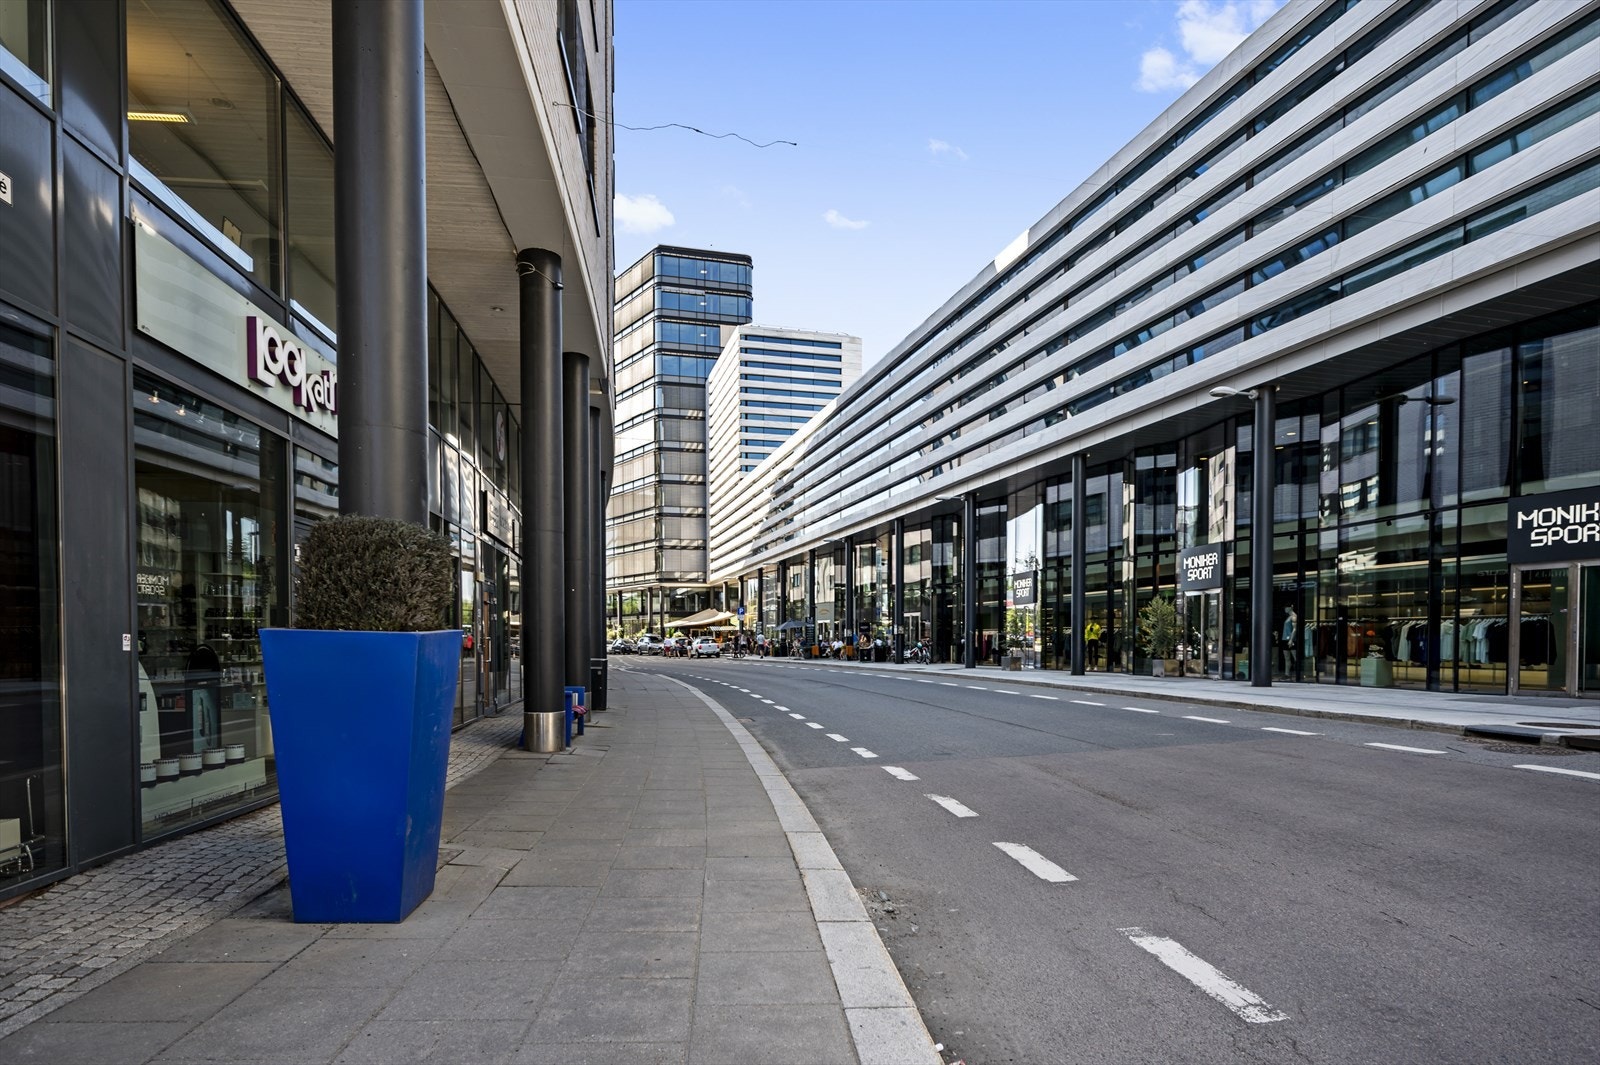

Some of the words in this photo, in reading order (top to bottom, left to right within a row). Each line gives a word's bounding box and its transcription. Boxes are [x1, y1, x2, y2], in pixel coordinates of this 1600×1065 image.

[1530, 523, 1600, 548] SPOR
[1183, 552, 1218, 570] MONIKER
[1187, 566, 1214, 582] SPORT
